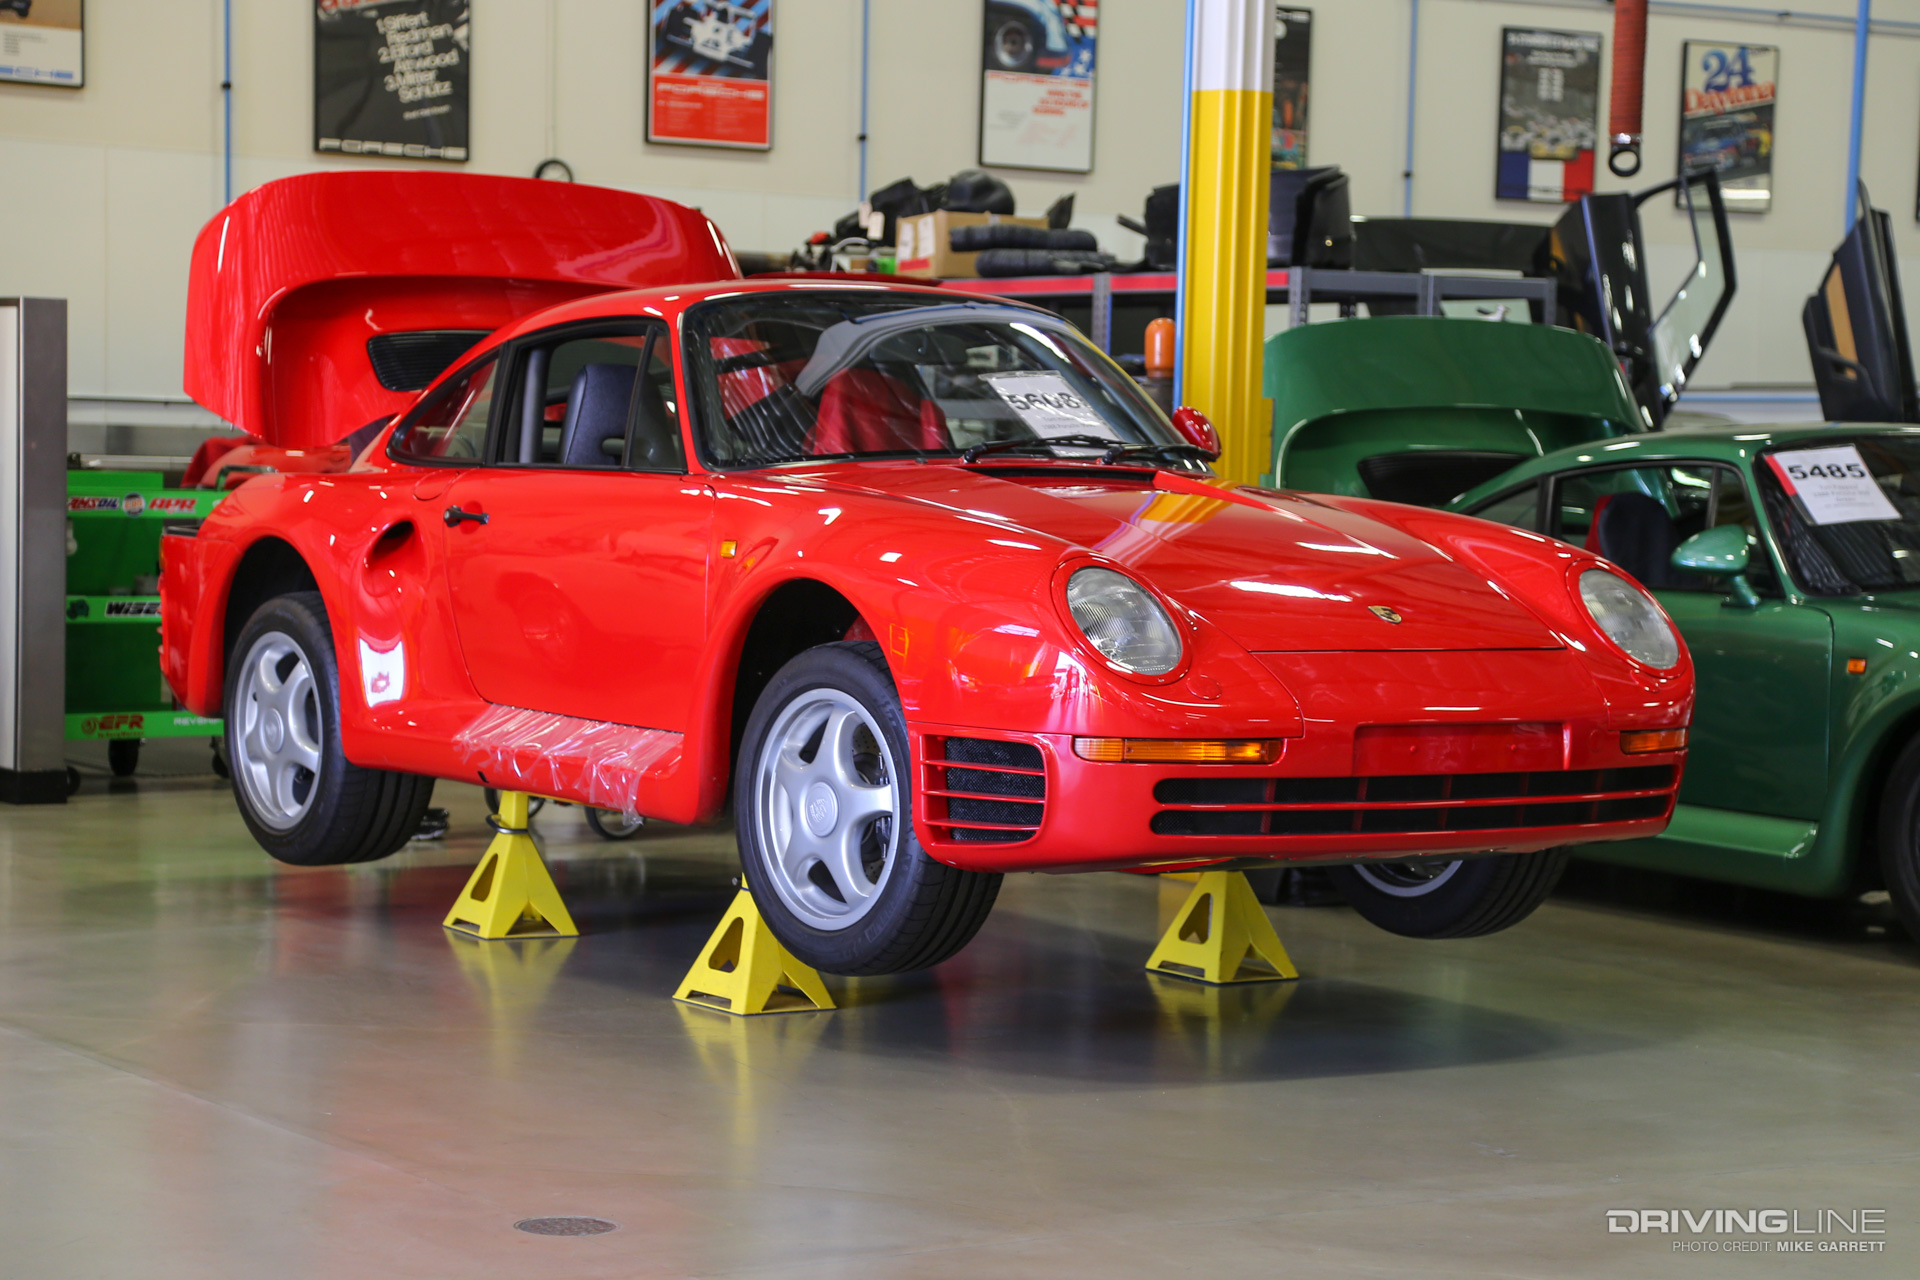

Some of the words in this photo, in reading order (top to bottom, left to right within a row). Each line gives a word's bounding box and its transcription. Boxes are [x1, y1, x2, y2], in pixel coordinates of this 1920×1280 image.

[1702, 46, 1757, 92] 24
[1685, 82, 1776, 115] Daytona
[319, 137, 467, 160] PORSCHE
[1007, 392, 1081, 411] 5608
[1788, 463, 1867, 480] 5485
[67, 497, 119, 510] AMSOIL
[149, 498, 197, 511] APR
[105, 601, 161, 617] WISE
[97, 714, 144, 730] EFR
